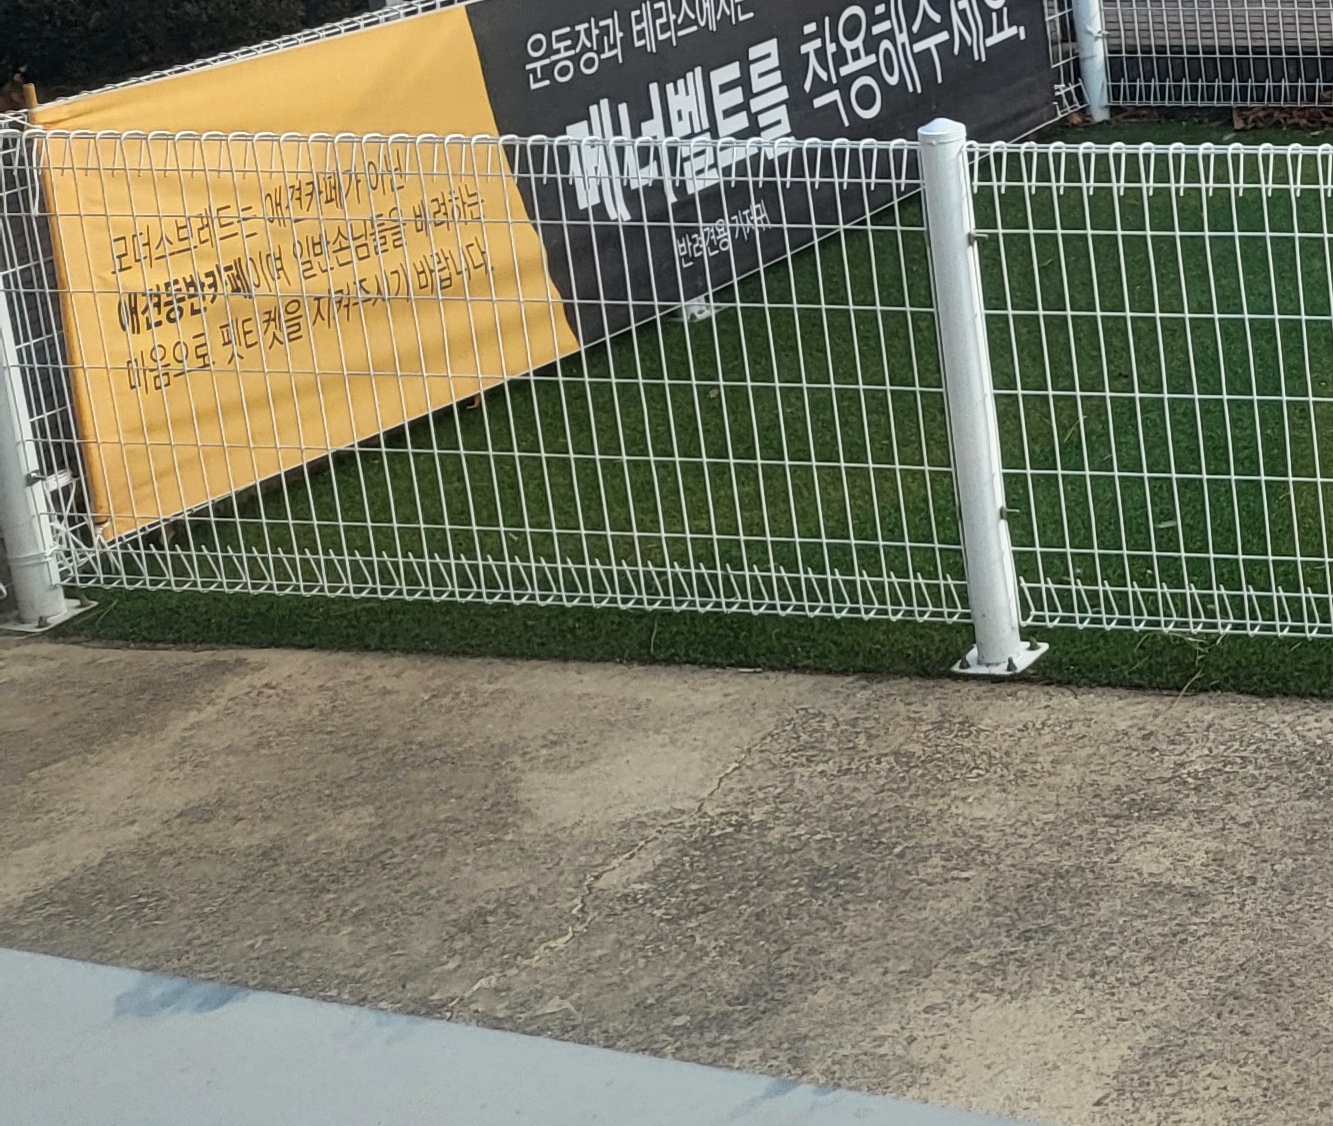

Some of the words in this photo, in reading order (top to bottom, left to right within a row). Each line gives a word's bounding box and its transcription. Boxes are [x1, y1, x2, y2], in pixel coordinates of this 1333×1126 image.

[524, 9, 625, 91] 운동장과
[110, 204, 258, 275] 모더스브레드는
[367, 149, 406, 196] 아닌
[292, 206, 408, 281] 일반손님들을
[413, 183, 486, 237] 배려하는
[676, 218, 730, 268] 반려견용
[731, 199, 772, 241] 기저귀
[126, 332, 216, 395] 마음으로
[311, 263, 412, 329] 지켜주시기
[413, 236, 494, 295] 바랍니다.
